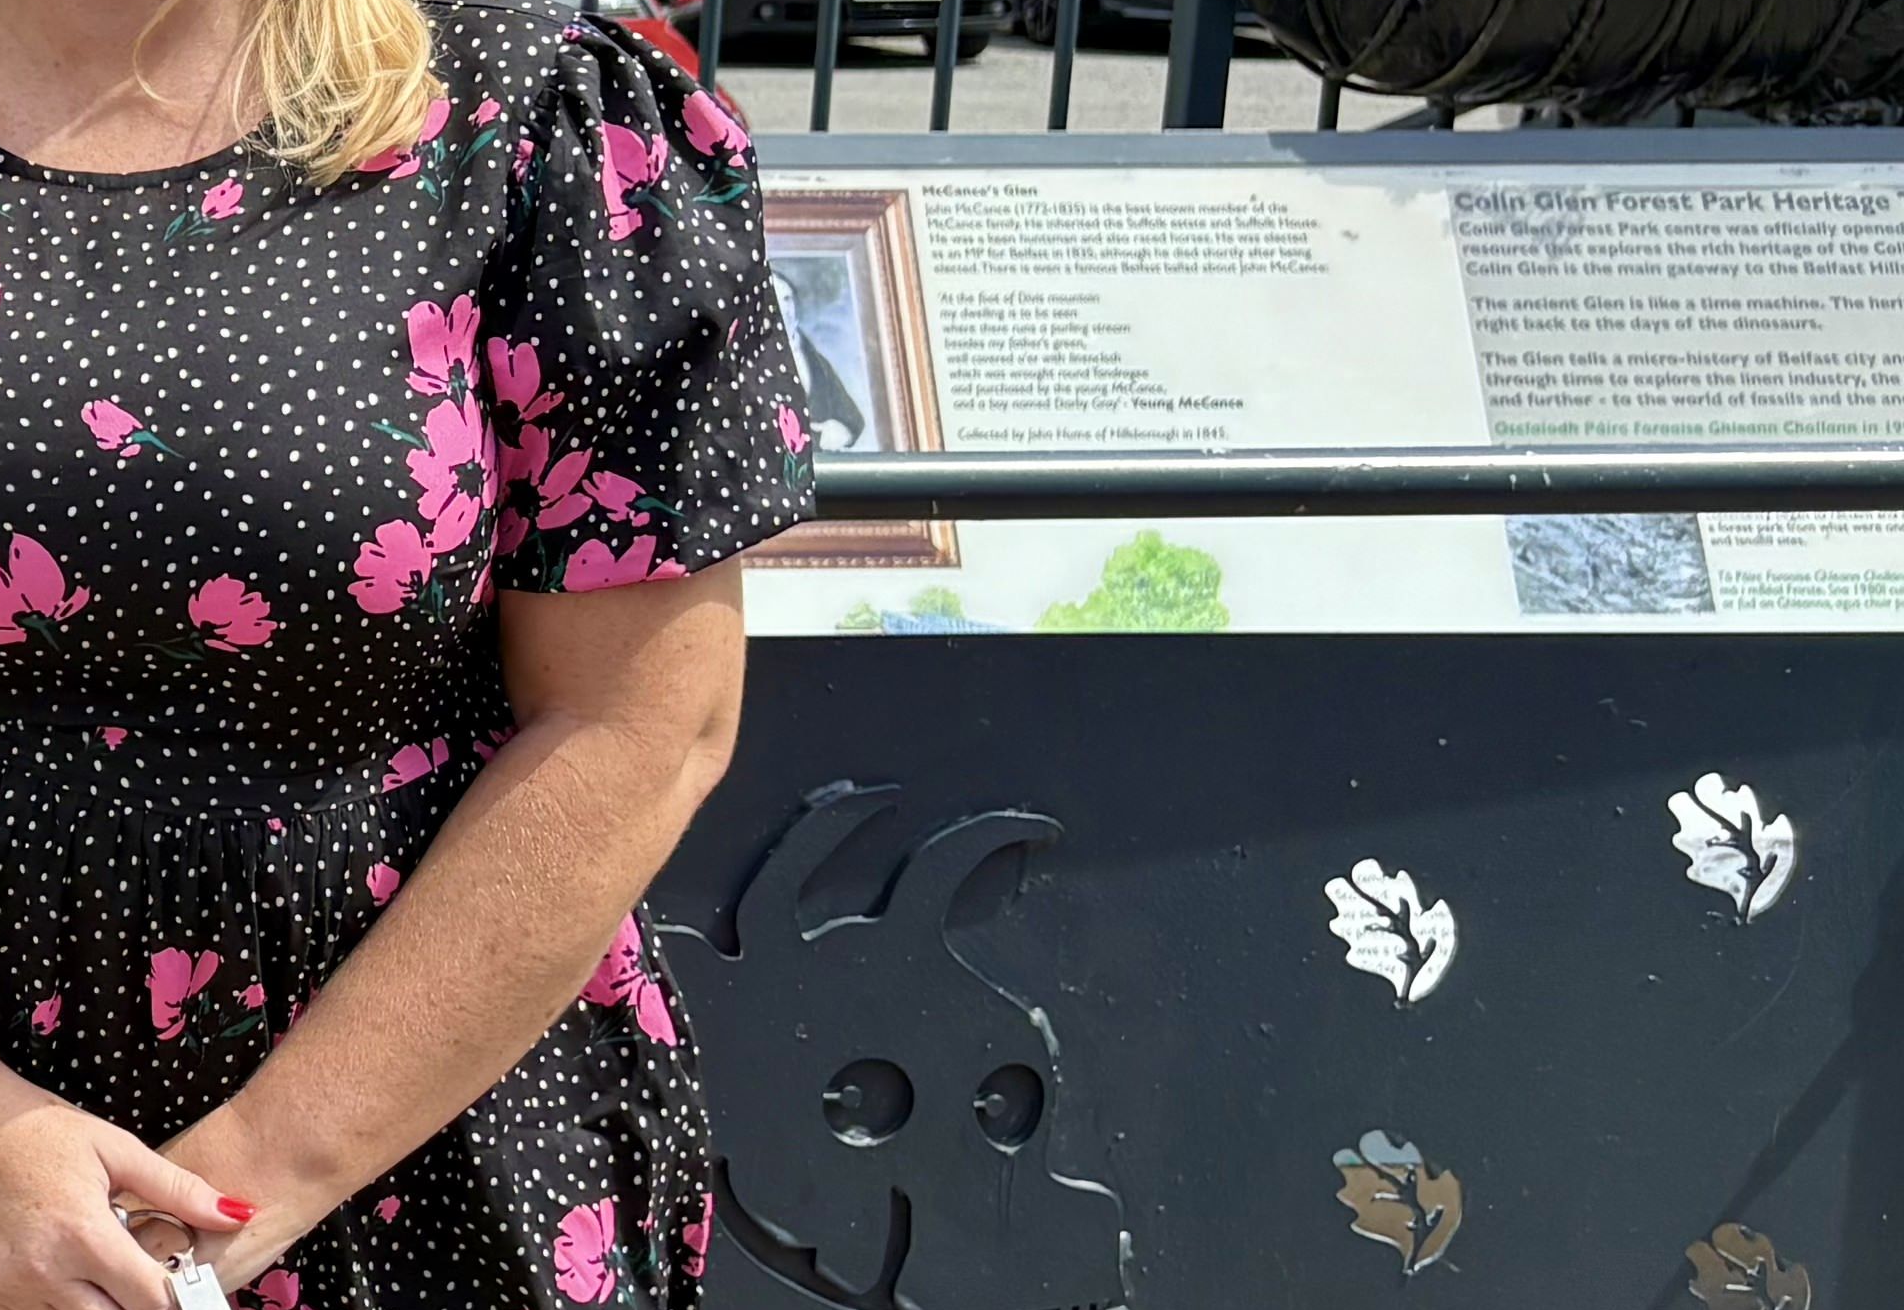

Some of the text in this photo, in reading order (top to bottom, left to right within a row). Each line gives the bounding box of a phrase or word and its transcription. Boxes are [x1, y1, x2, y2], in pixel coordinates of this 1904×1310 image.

[1454, 191, 1890, 217] Colin Glen Forest Park Heritage
[1458, 221, 1506, 237] Colin
[1510, 221, 1554, 237] Glen
[1555, 222, 1613, 236] Forest
[1617, 221, 1659, 236] Park
[1664, 223, 1721, 236] centre
[1725, 224, 1759, 236] was
[1763, 221, 1837, 239] officially
[1465, 261, 1513, 276] Colin
[1517, 259, 1559, 276] Glen
[1563, 262, 1578, 275] is
[1582, 261, 1613, 276] the
[1617, 261, 1662, 276] main
[1666, 263, 1739, 279] gateway
[1744, 262, 1764, 275] to
[1768, 261, 1799, 275] the
[1802, 260, 1865, 275] Belfast
[1472, 295, 1865, 311] The ancient Glen is like a time machine. The
